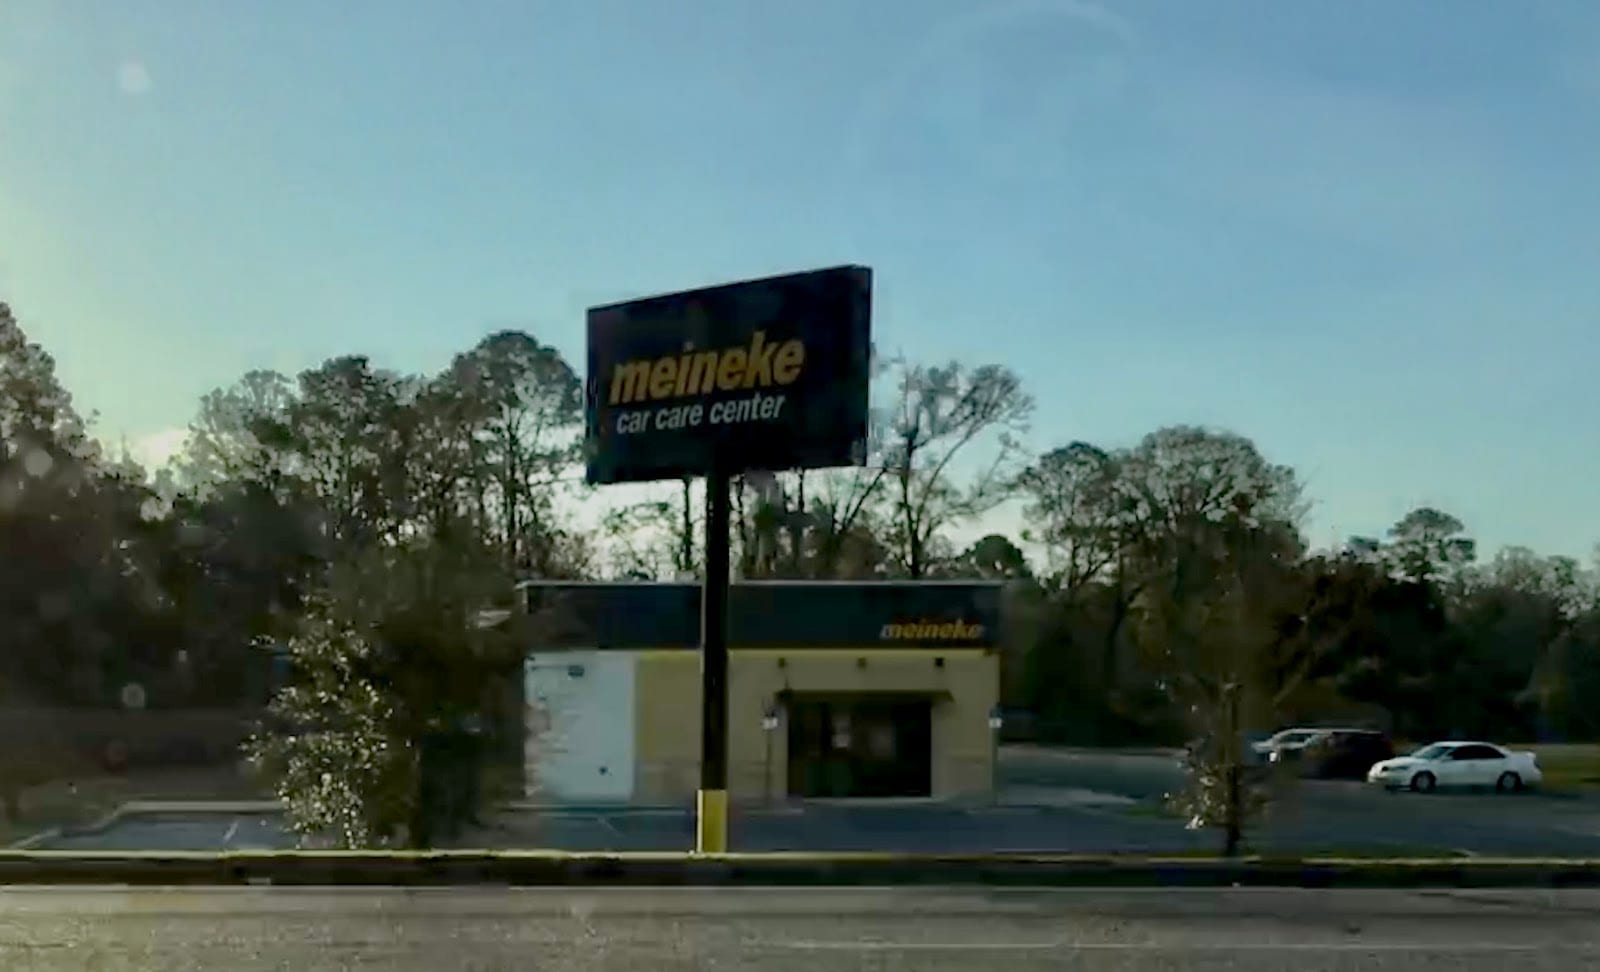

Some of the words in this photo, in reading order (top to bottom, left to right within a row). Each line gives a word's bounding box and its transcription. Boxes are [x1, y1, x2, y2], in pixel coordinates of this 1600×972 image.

[610, 331, 805, 404] meineke
[616, 412, 651, 434] car
[655, 403, 703, 430] care
[709, 393, 785, 424] center
[880, 619, 984, 639] meineke
